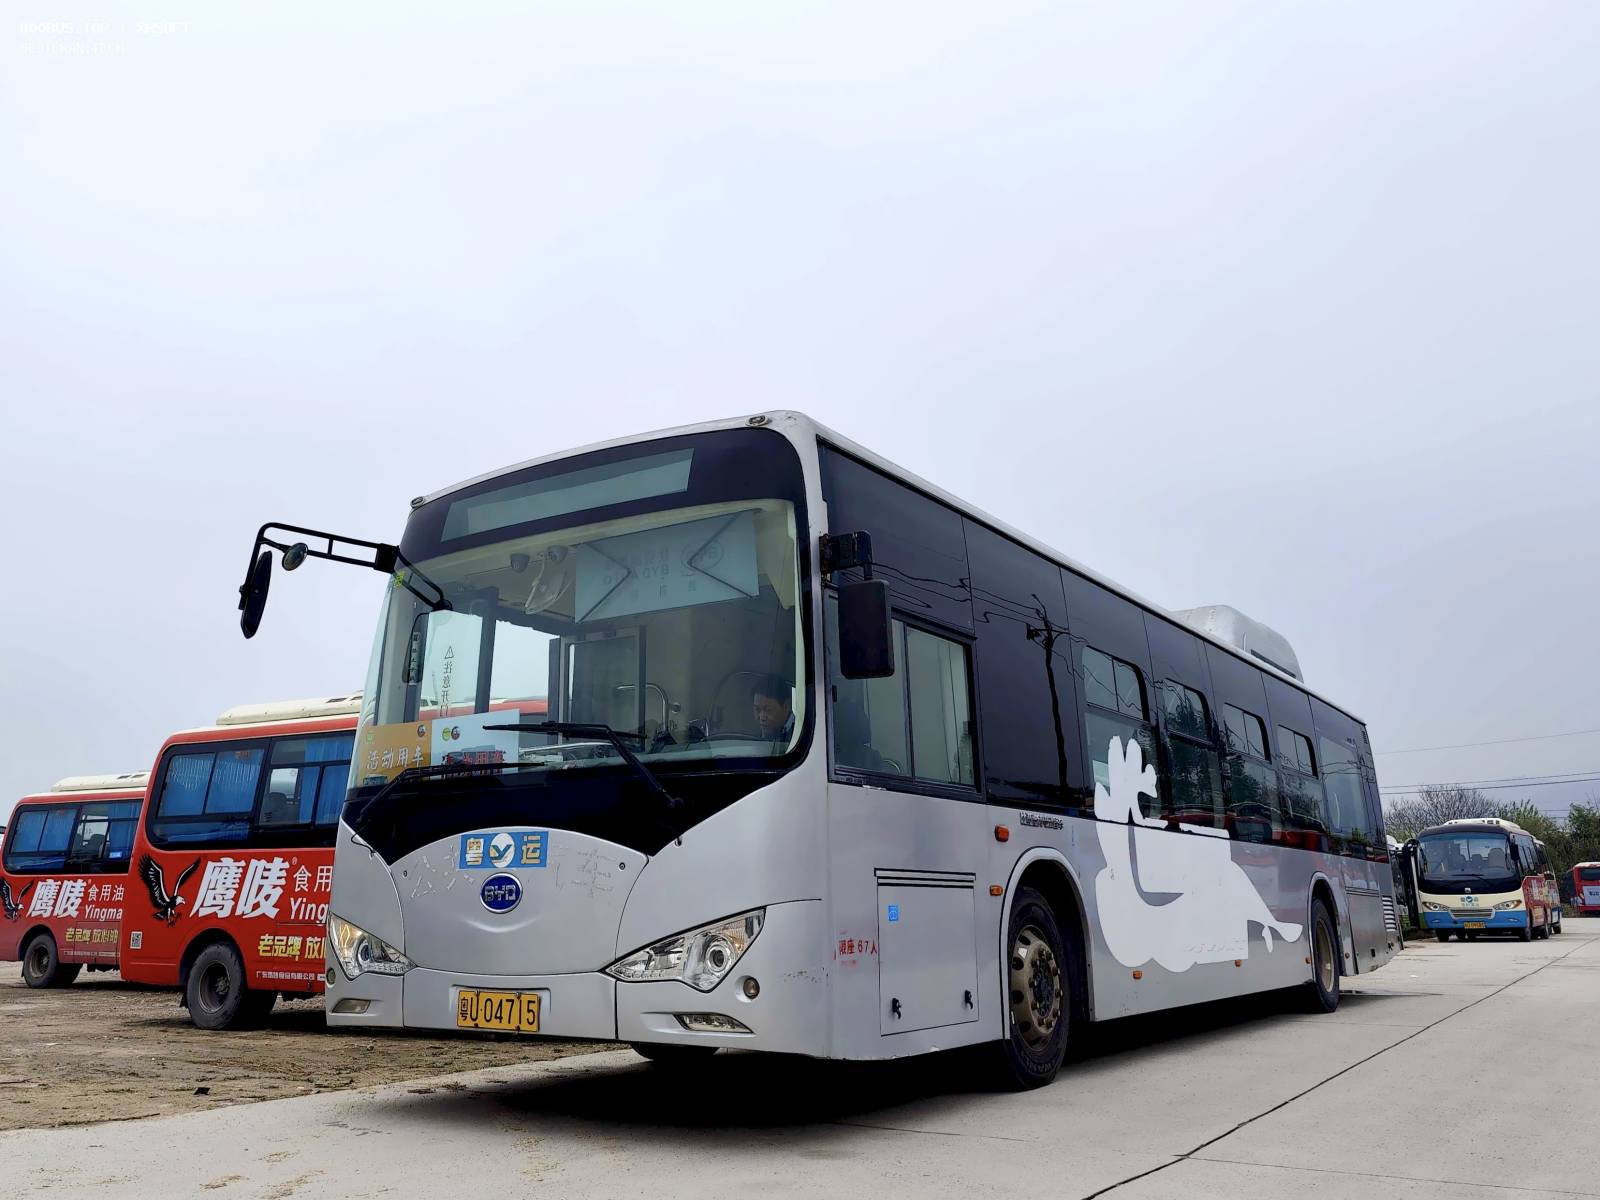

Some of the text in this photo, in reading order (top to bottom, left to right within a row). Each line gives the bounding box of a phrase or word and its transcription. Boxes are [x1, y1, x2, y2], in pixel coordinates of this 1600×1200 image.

[366, 745, 424, 769] 活动用车
[26, 878, 124, 918] 鹰唛 食用油
[189, 857, 290, 919] 鹰唛
[484, 884, 516, 902] BYD
[85, 904, 123, 921] Yingma
[258, 933, 302, 961] 老品牌
